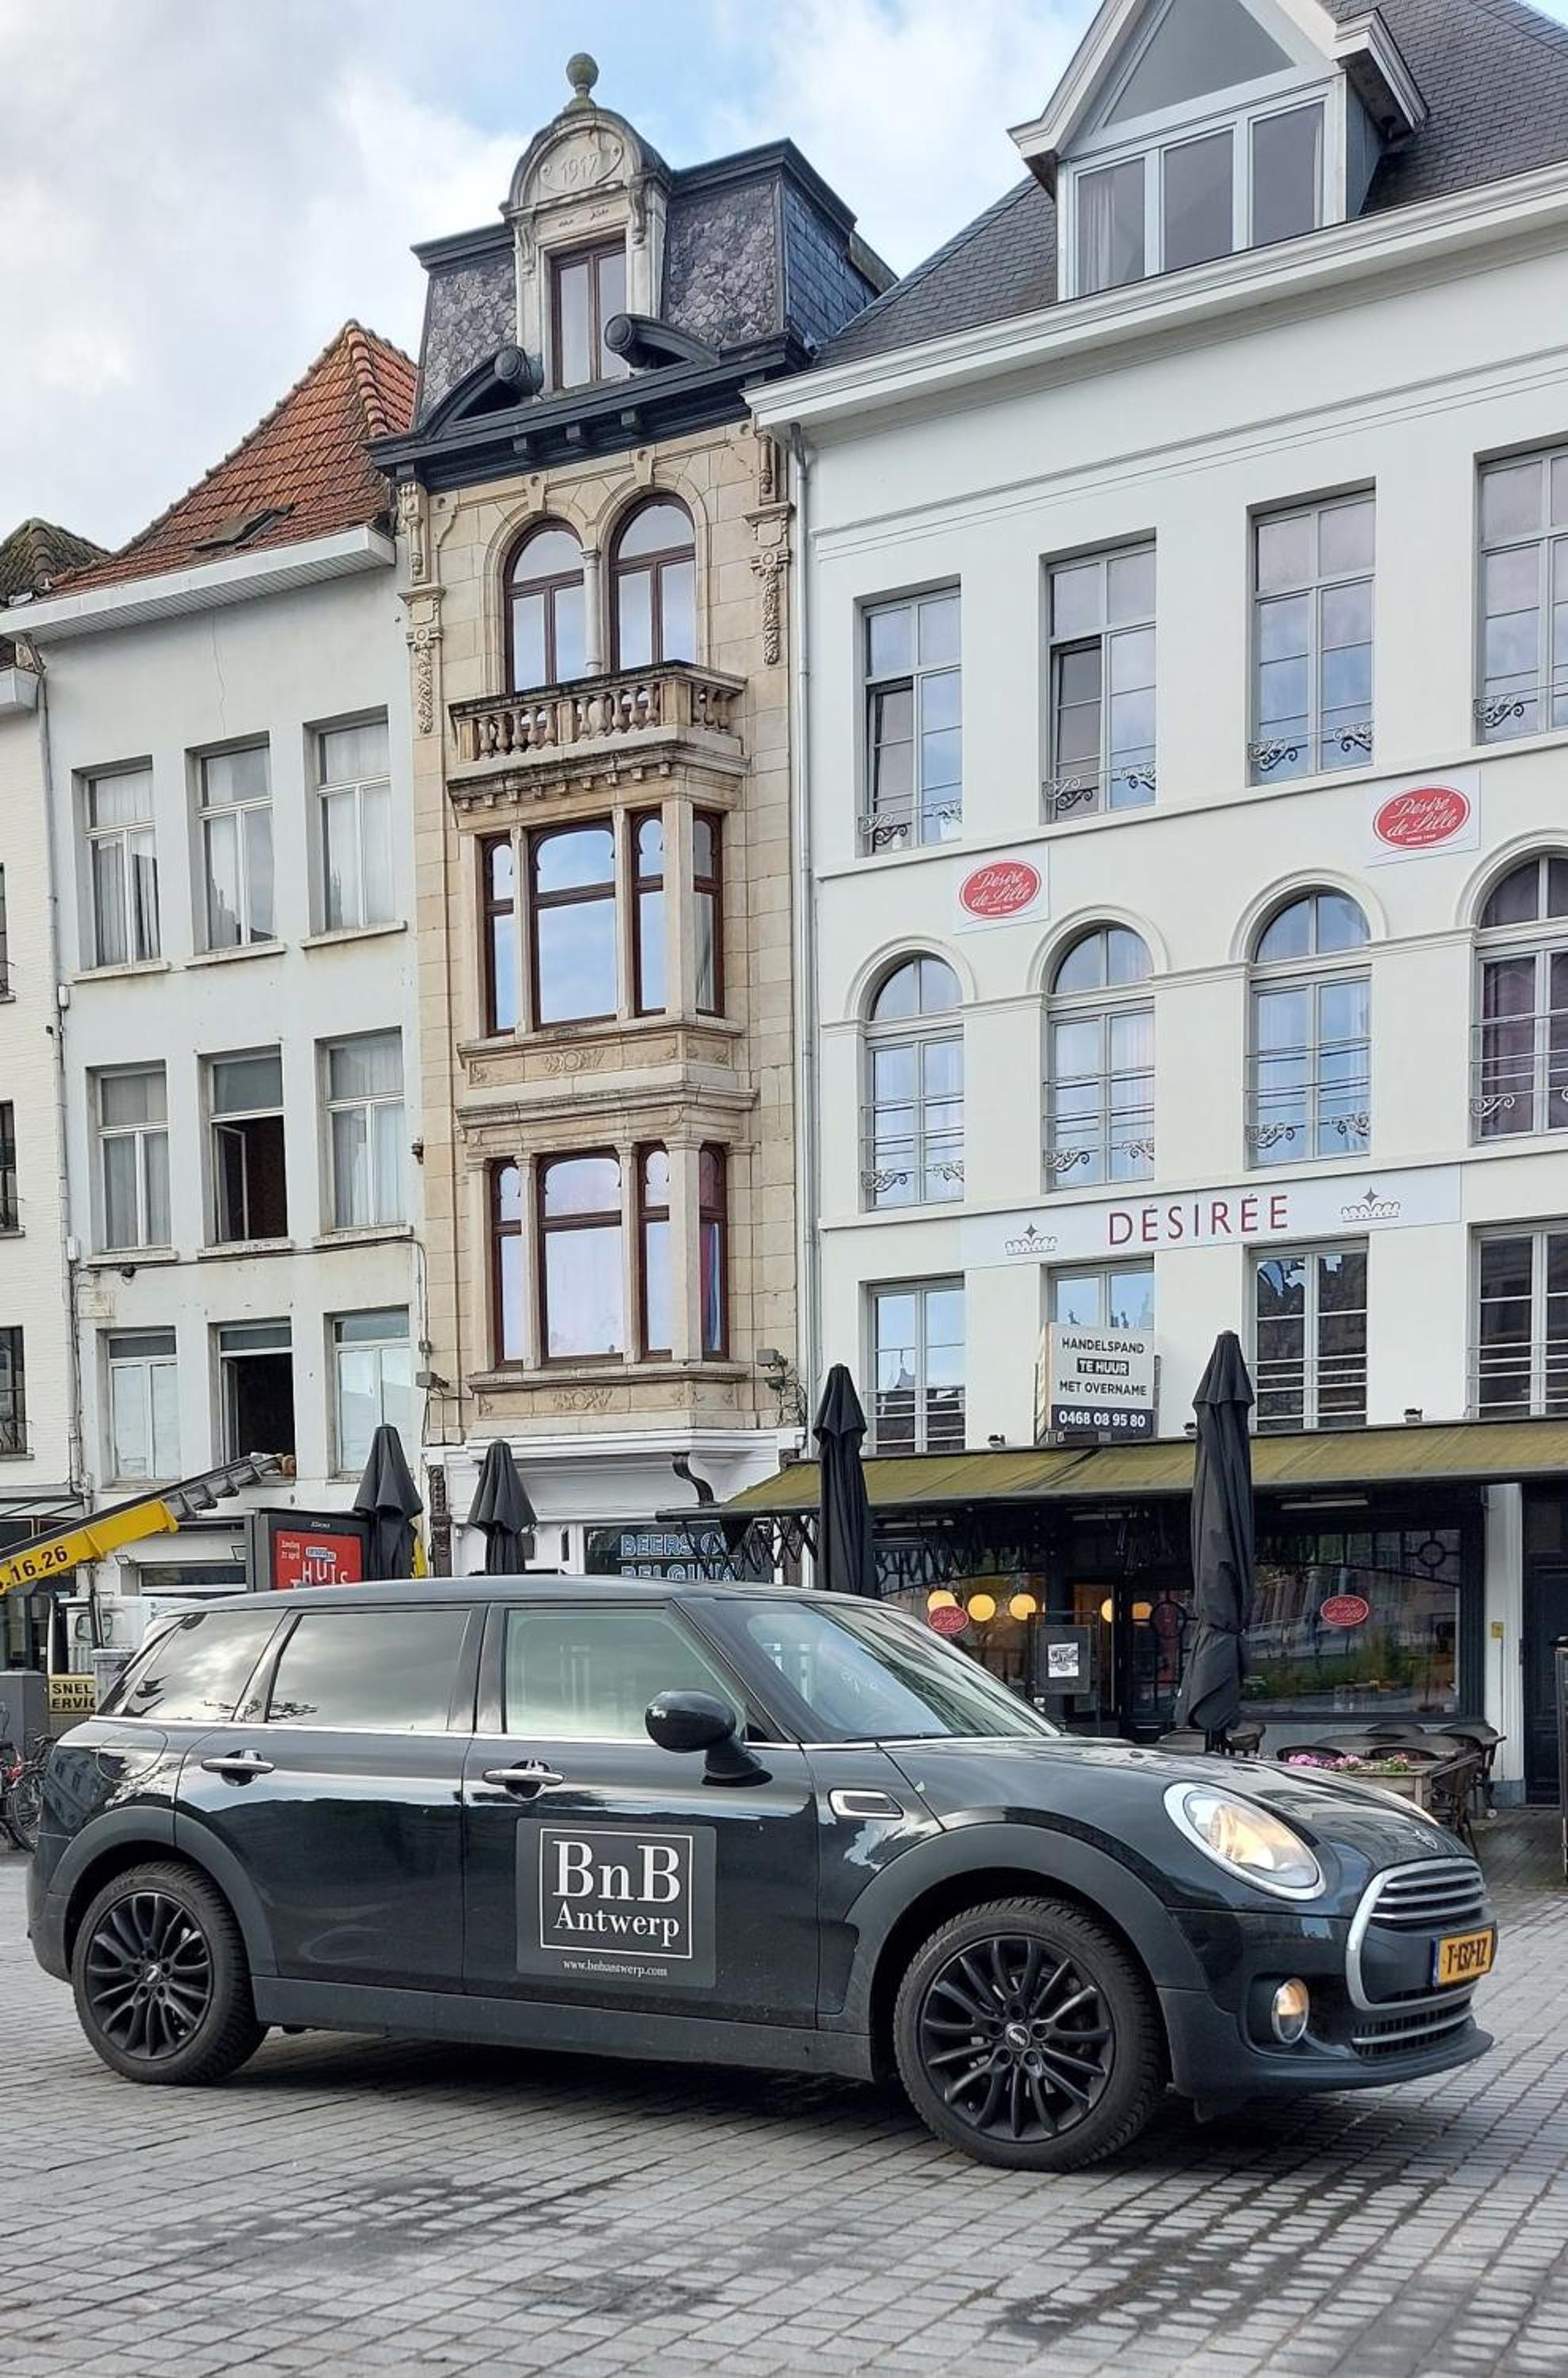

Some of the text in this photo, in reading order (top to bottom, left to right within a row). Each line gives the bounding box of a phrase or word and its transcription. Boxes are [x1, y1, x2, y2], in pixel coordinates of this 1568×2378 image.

[1387, 818, 1408, 837] de
[971, 890, 989, 908] de
[1109, 1193, 1288, 1245] DÉSIRÉE
[1061, 1337, 1145, 1354] HANDELSPAND
[1079, 1359, 1128, 1374] TE HUUR
[1084, 1382, 1148, 1396] OVERNAME
[1058, 1410, 1146, 1428] 0468 08 95 80
[621, 1533, 695, 1557] BEERS
[52, 1683, 94, 1695] SNEL
[553, 1840, 681, 1902] BnB
[553, 1899, 680, 1948] Antwerp
